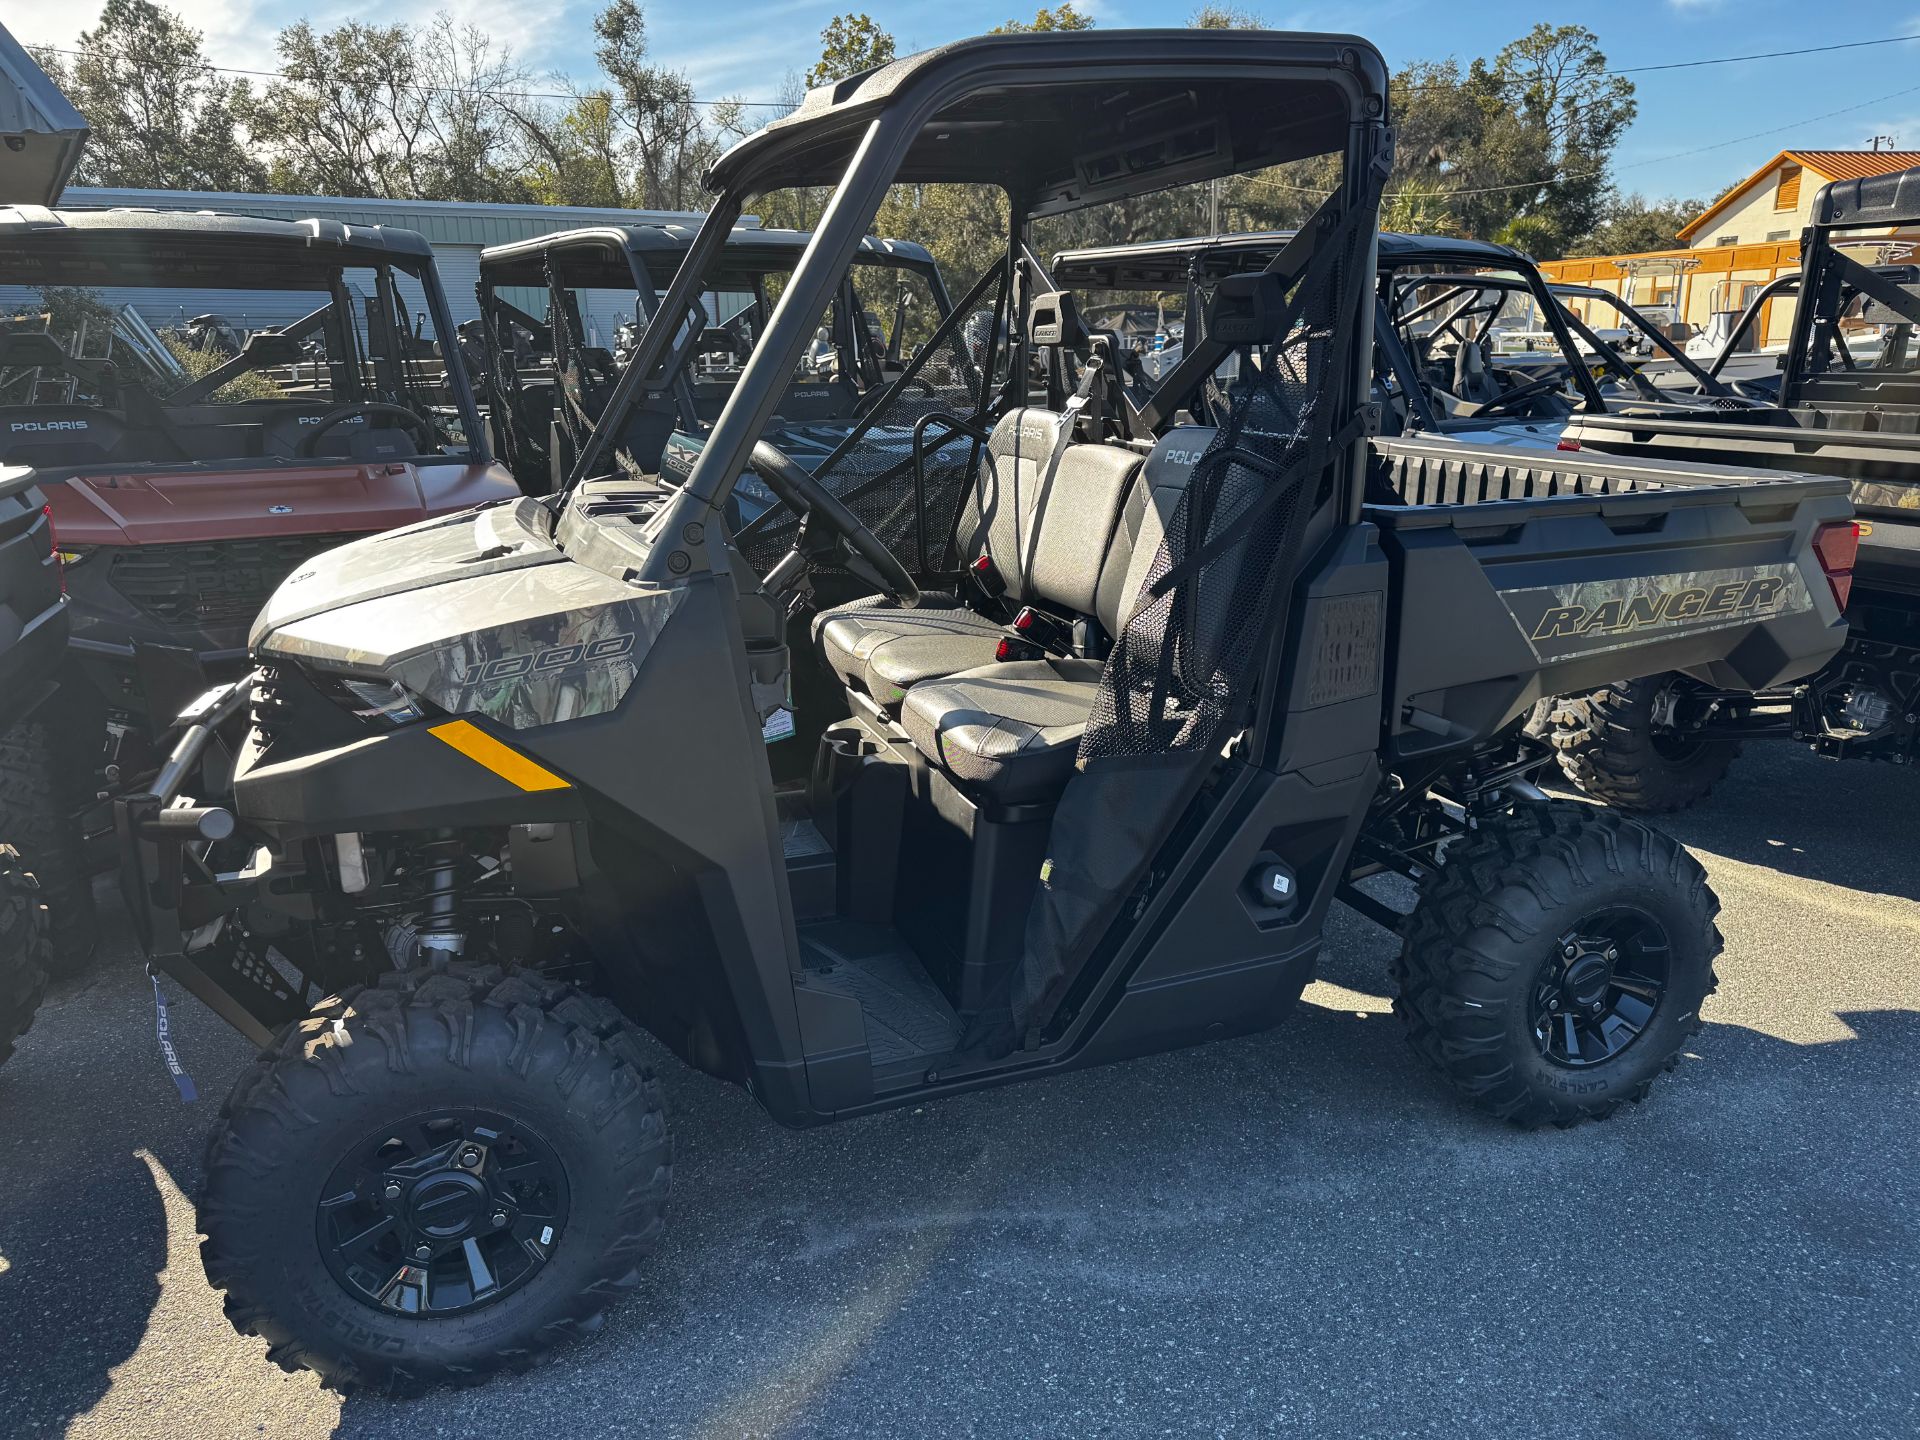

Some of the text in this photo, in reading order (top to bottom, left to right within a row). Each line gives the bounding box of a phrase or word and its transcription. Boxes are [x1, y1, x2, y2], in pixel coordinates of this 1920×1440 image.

[10, 421, 88, 432] POLARIS
[1008, 425, 1044, 440] POLARIS
[1164, 449, 1203, 466] POLA
[1531, 576, 1783, 640] RANGER
[463, 632, 635, 686] 1000
[158, 1005, 183, 1075] POLARIS
